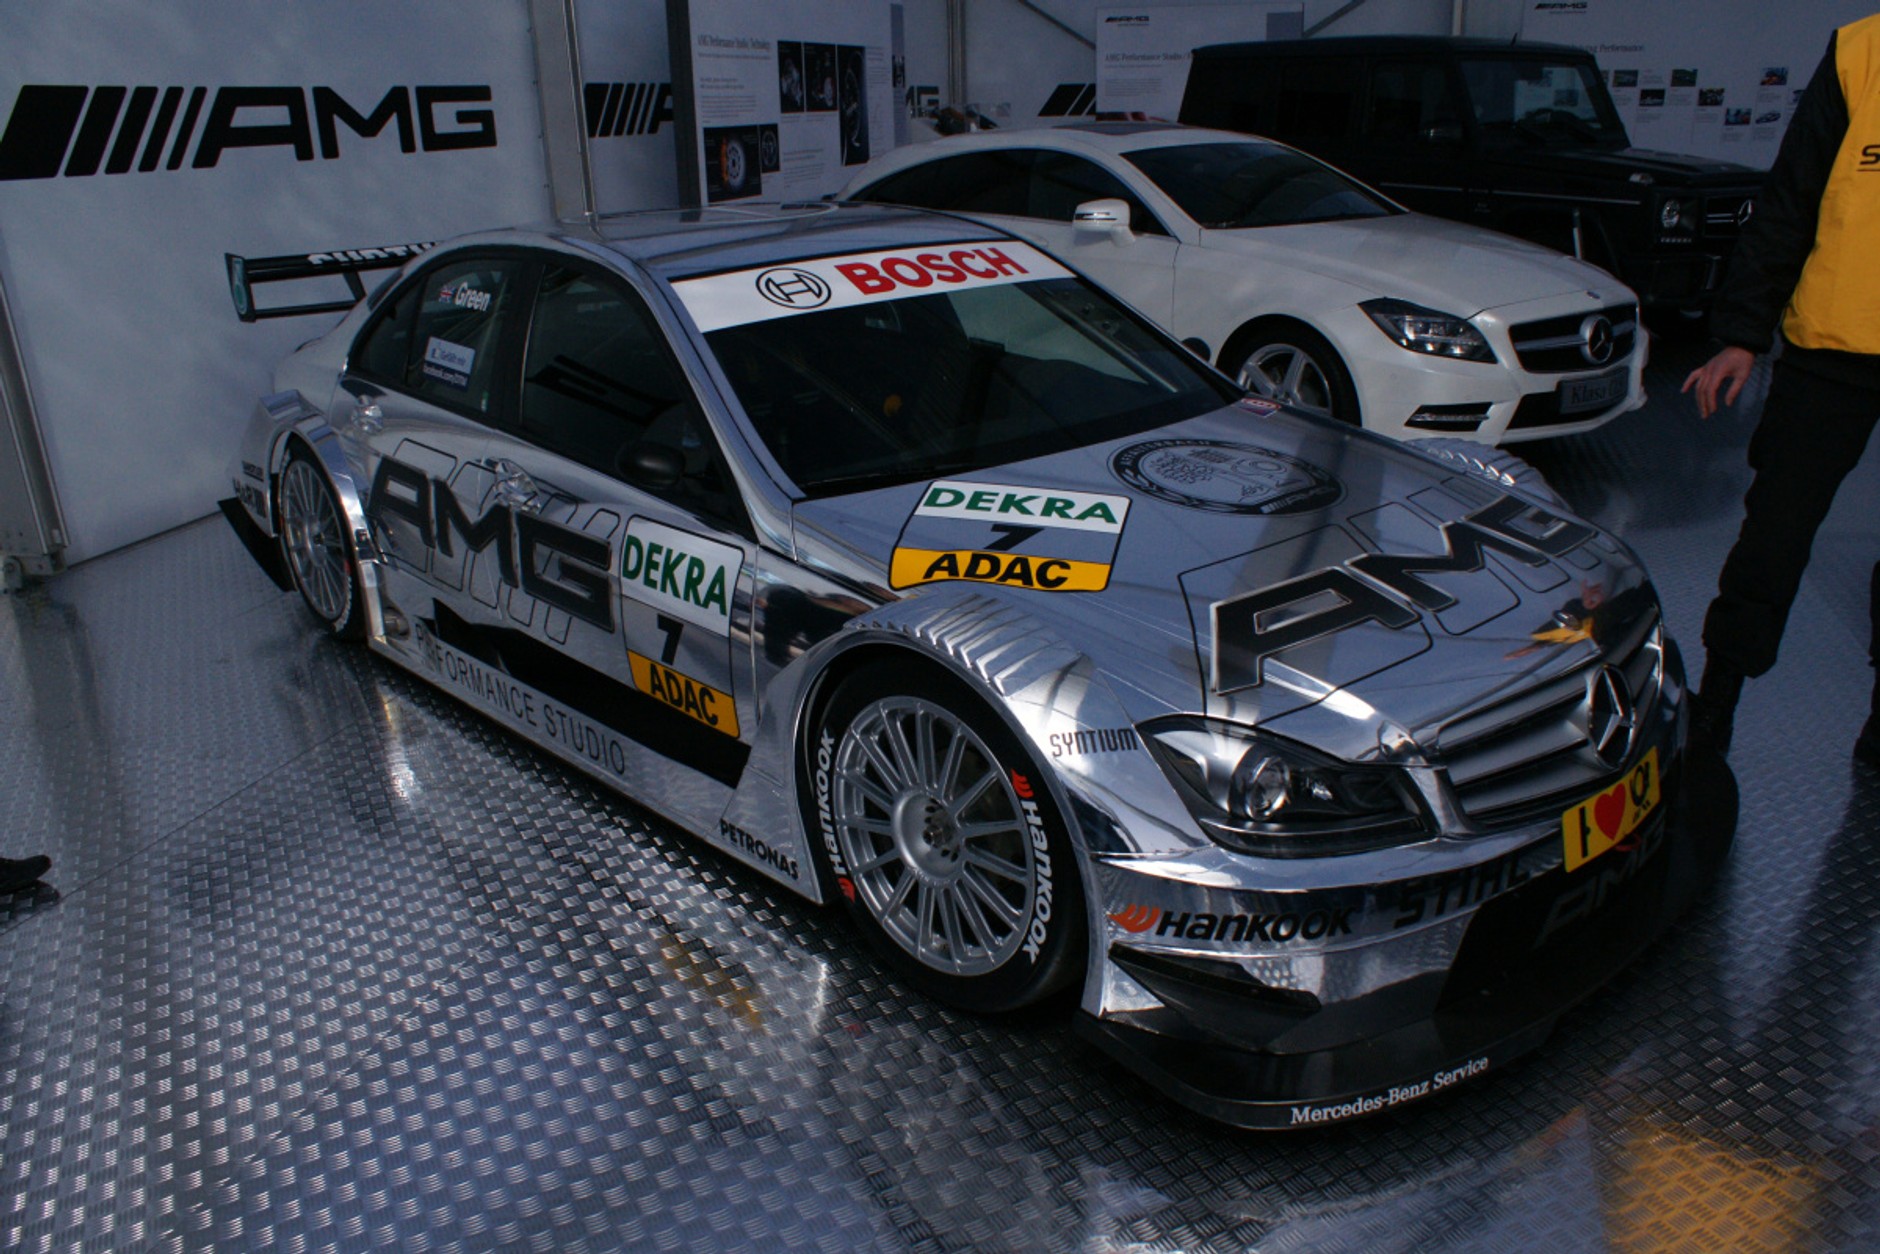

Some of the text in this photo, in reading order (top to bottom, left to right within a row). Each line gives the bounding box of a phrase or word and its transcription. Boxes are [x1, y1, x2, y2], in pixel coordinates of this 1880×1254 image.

[193, 86, 498, 168] AMG
[455, 281, 492, 312] Green
[835, 247, 1030, 296] BOSCH
[923, 487, 1118, 525] DEKRA
[984, 524, 1045, 551] 7
[366, 456, 615, 633] AMG
[622, 535, 727, 616] DEKRA
[922, 552, 1071, 588] ADAC
[1210, 495, 1600, 695] AMG
[657, 613, 684, 665] 7
[650, 663, 719, 726] ADAC
[543, 703, 625, 775] STUDIO
[1049, 728, 1138, 758] SYNTIUM
[719, 818, 799, 881] PETRONAS
[1289, 1056, 1489, 1125] Mercedes-Benz Service
